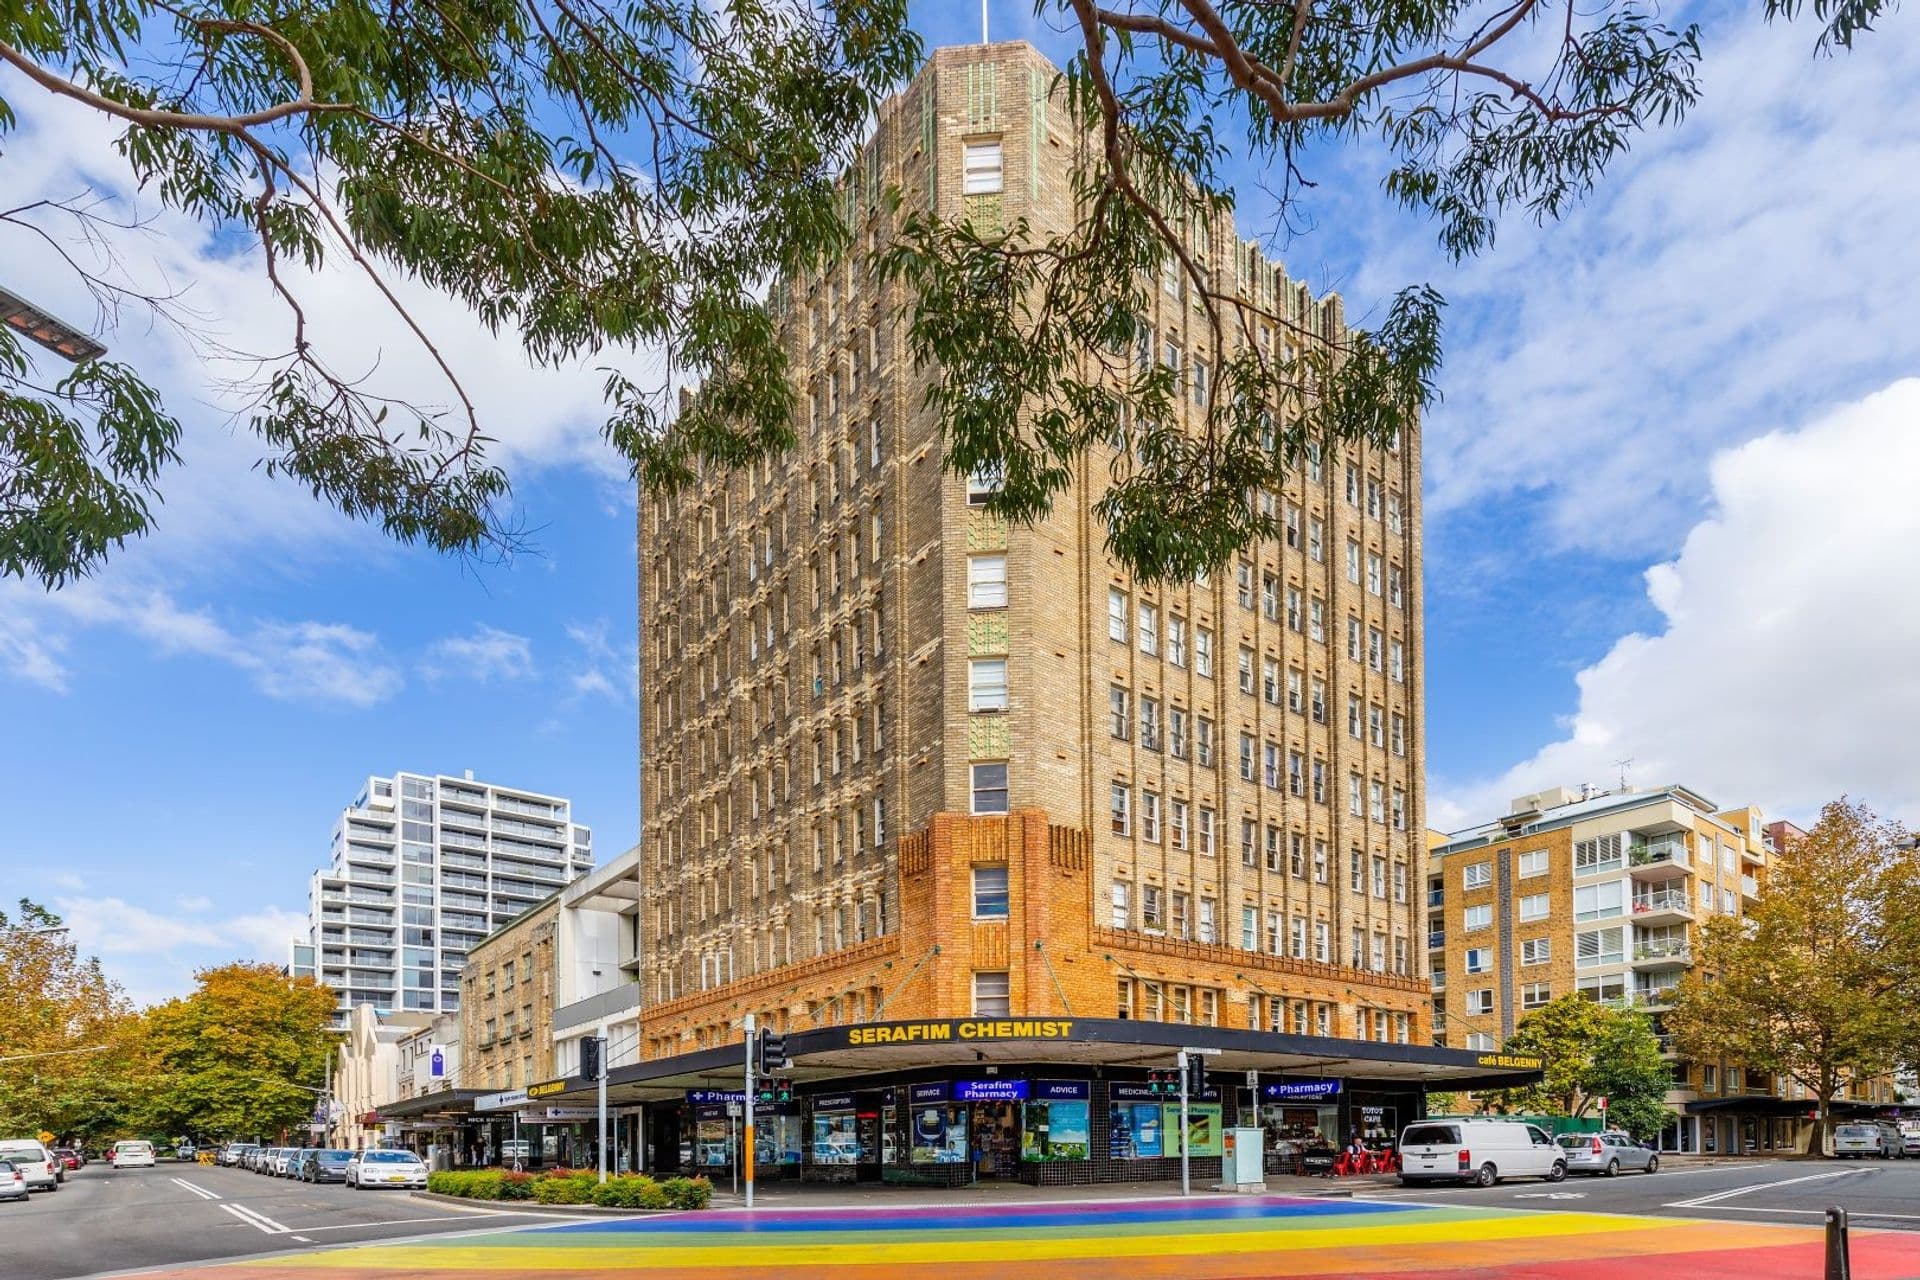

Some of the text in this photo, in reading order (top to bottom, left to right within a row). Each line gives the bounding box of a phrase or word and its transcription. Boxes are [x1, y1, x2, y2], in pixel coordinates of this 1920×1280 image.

[849, 1022, 1072, 1044] SERAFIM CHEMIST
[971, 1081, 1012, 1090] Serafim
[1050, 1086, 1078, 1094] ADVICE
[1280, 1083, 1333, 1094] Pharmacy
[707, 1092, 760, 1101] Pharmc
[964, 1090, 1018, 1099] Pharmacy
